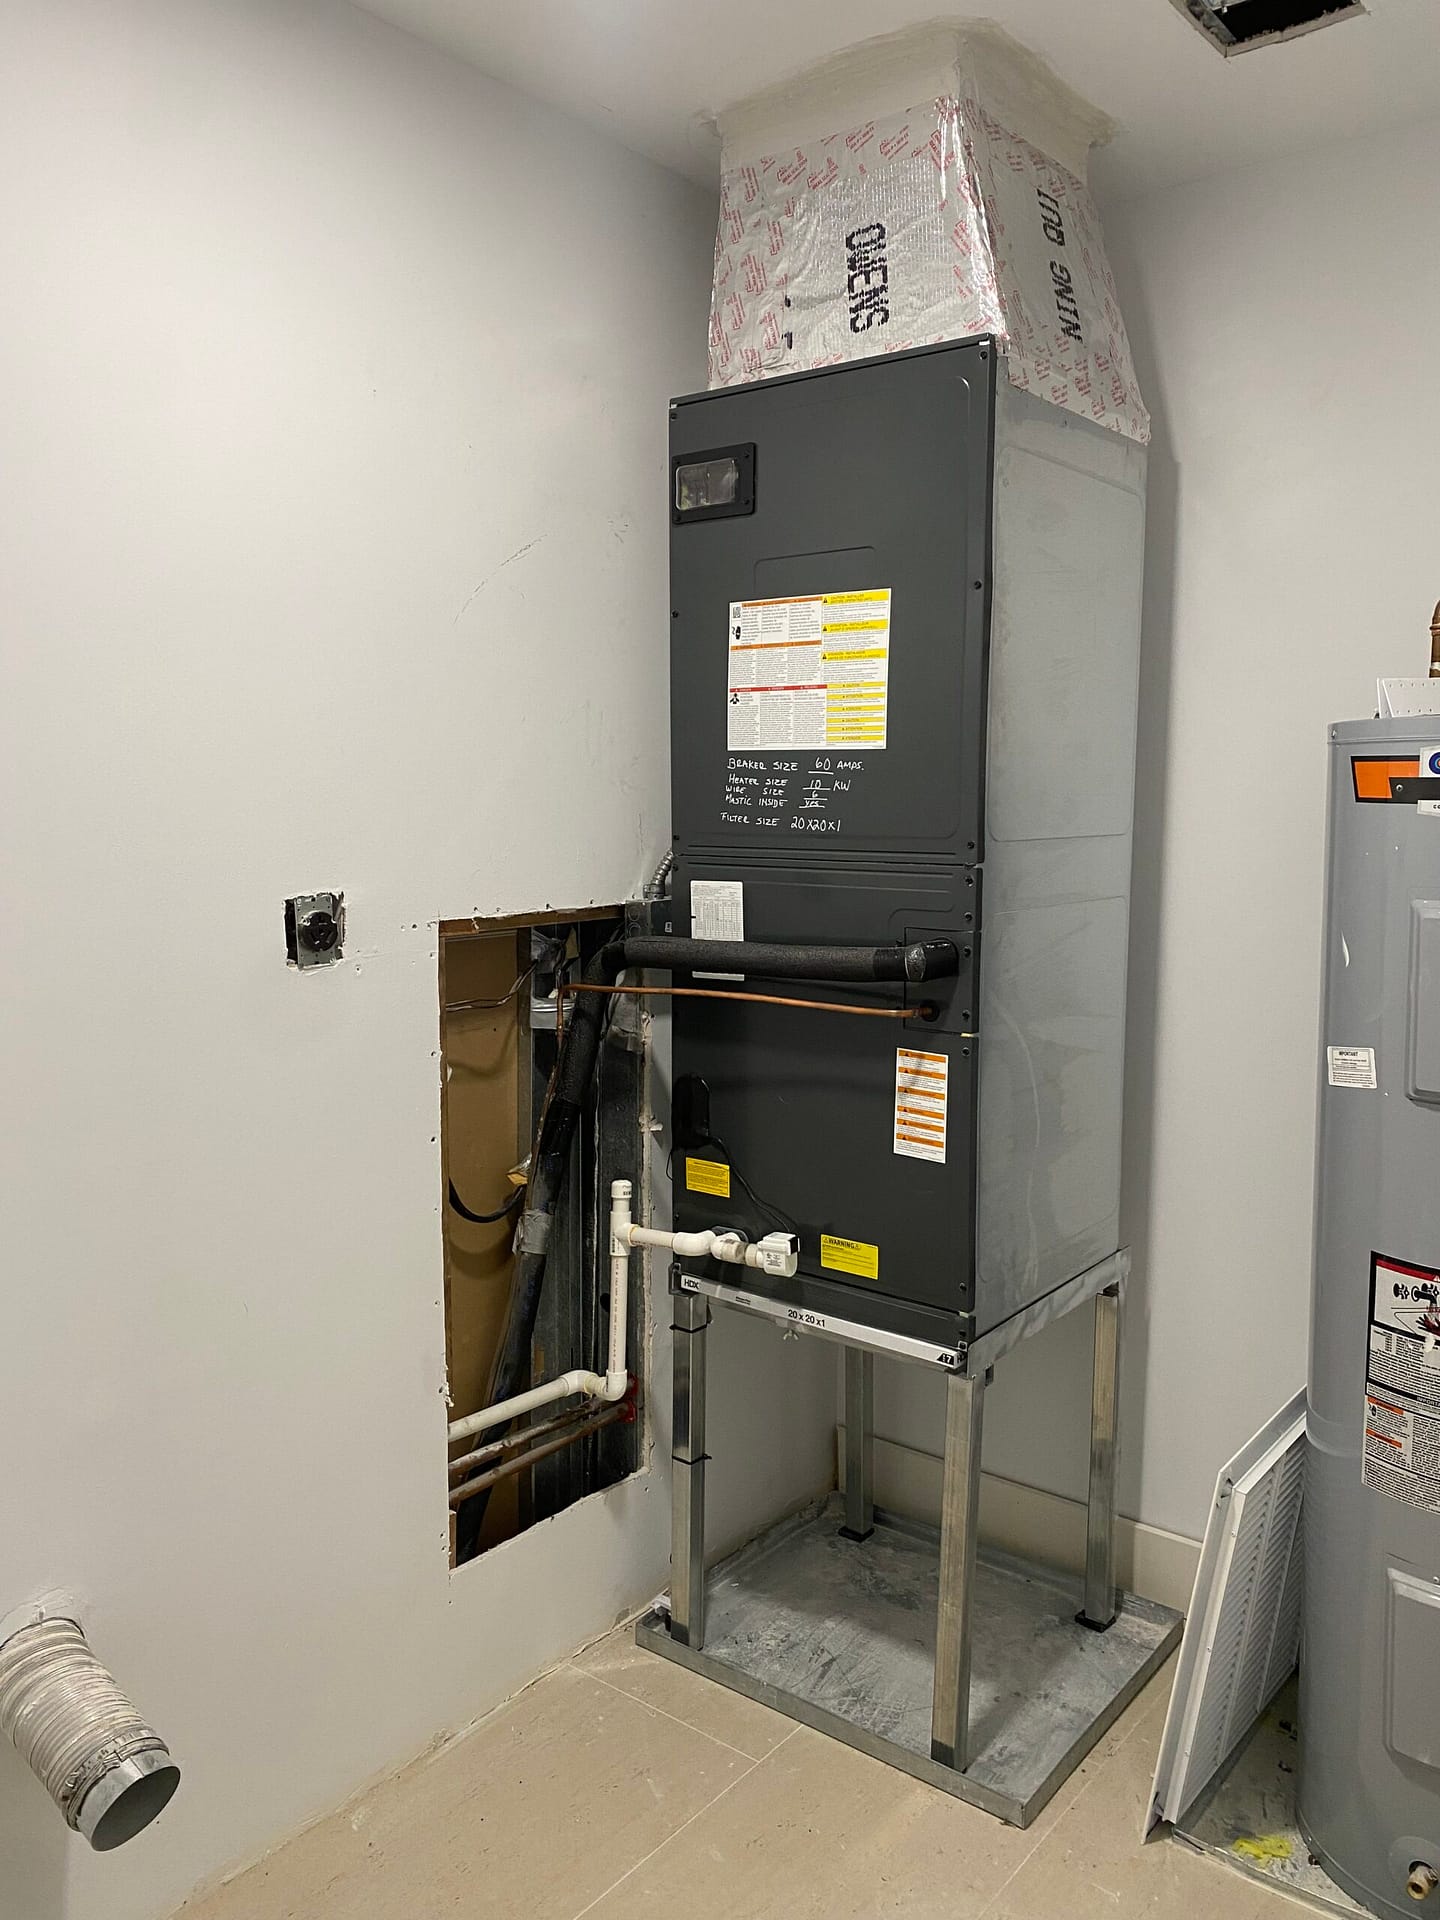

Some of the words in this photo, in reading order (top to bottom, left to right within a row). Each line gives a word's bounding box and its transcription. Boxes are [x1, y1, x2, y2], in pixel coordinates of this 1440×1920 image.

[846, 222, 890, 334] OWENS
[1049, 260, 1083, 345] NING
[727, 757, 767, 770] BRAKER
[773, 761, 799, 772] SIZE
[815, 757, 831, 771] 60
[728, 773, 760, 786] HEATER
[765, 779, 788, 787] SIZE
[810, 779, 822, 789] 10
[832, 779, 851, 792] KW
[725, 785, 747, 794] WIRE
[763, 787, 785, 796] SIZE
[758, 799, 788, 808] INSIDE
[720, 811, 750, 824] FILTER
[755, 818, 780, 827] SIZE
[827, 1238, 856, 1249] WARNING
[683, 1278, 700, 1290] HDX
[787, 1309, 798, 1320] 20
[804, 1312, 815, 1324] 20
[946, 1355, 952, 1364] 7
